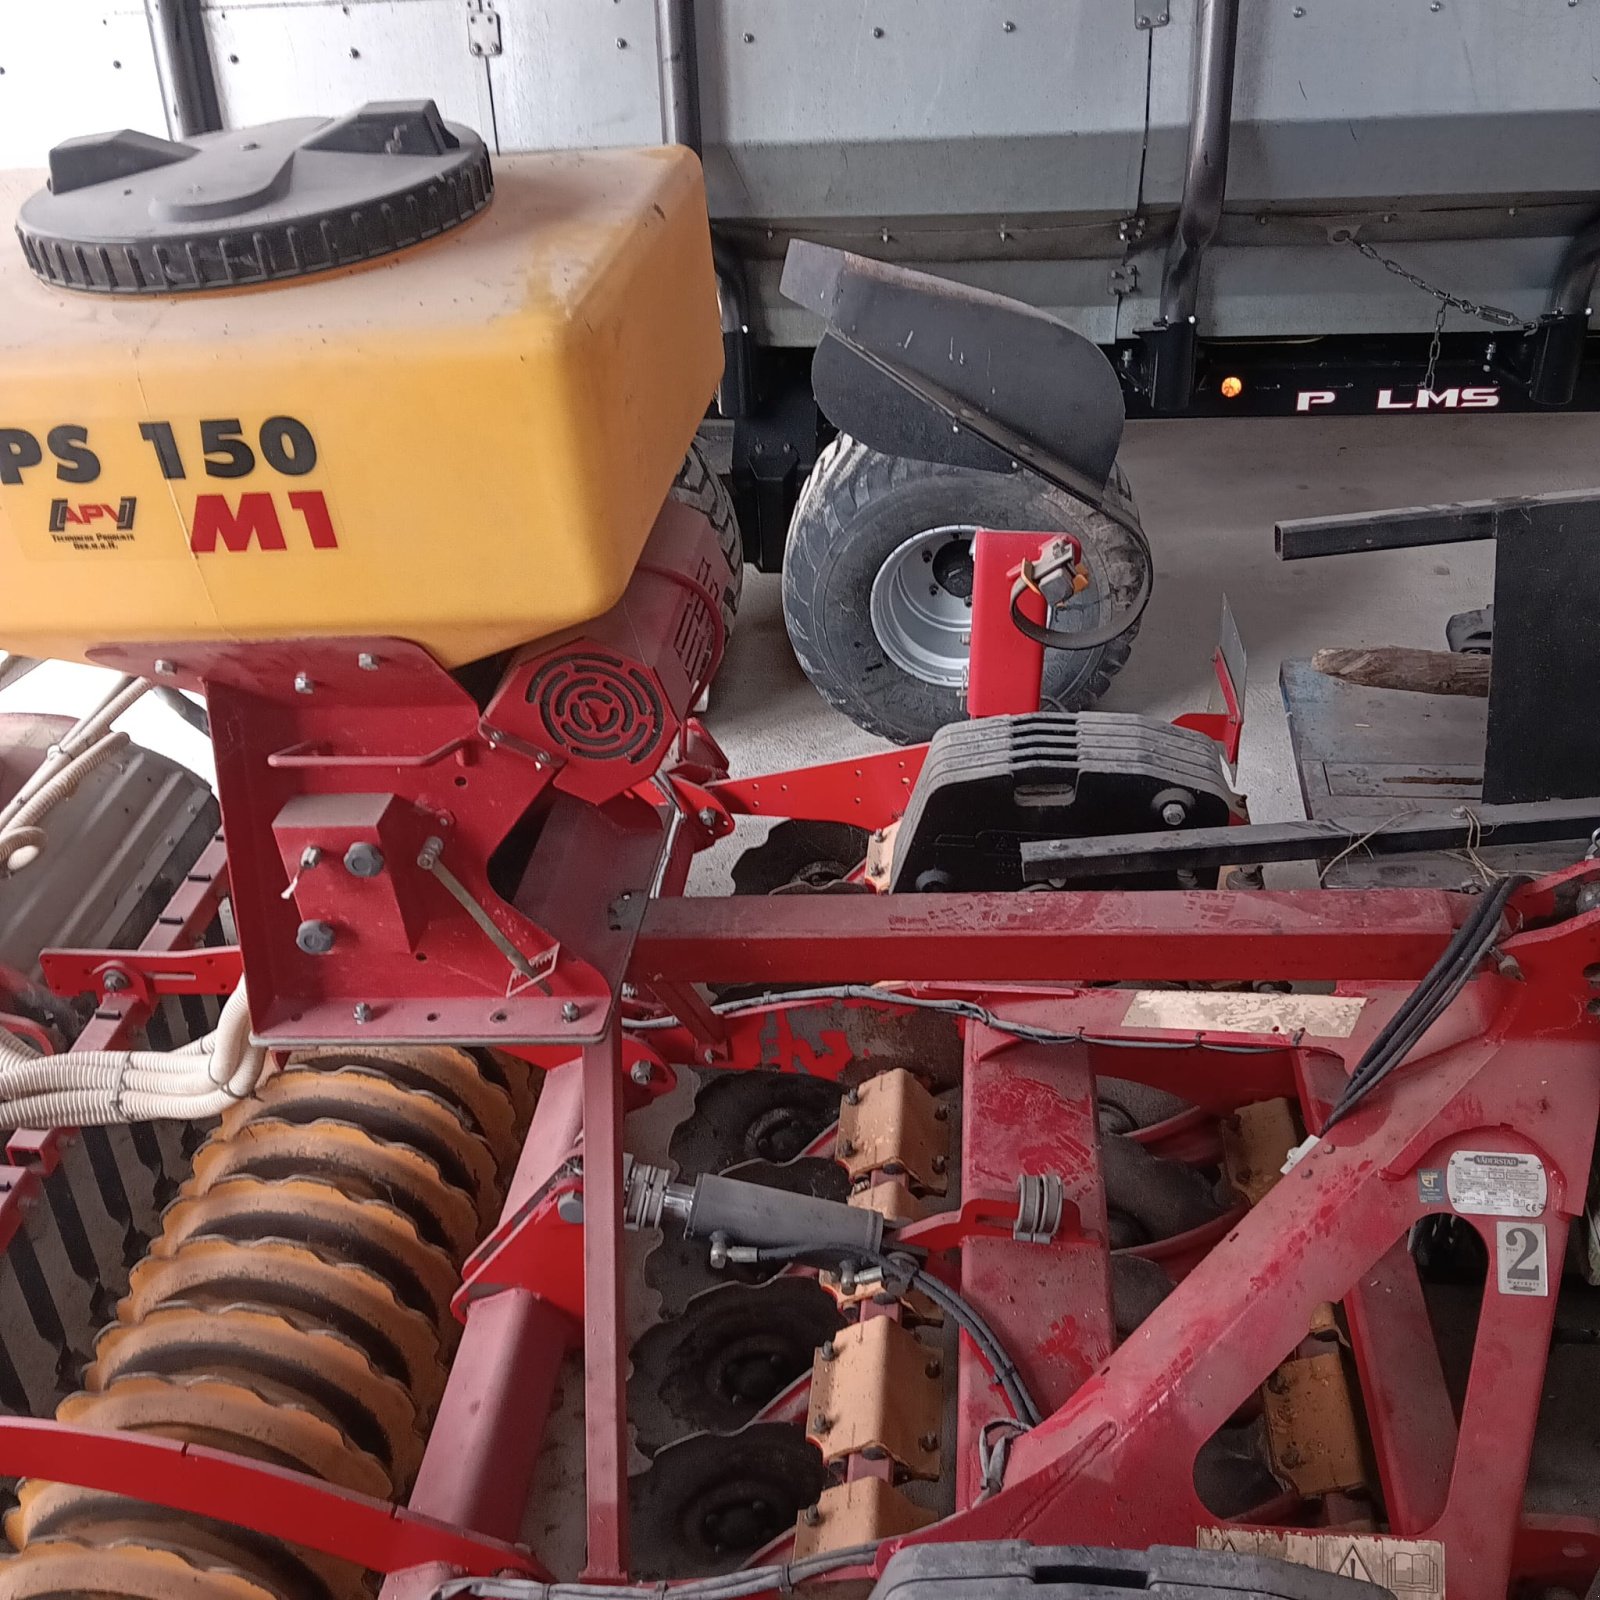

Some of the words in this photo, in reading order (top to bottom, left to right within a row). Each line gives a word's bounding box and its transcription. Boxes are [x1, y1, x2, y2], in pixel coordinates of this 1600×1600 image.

[1297, 391, 1336, 411] P
[1377, 388, 1500, 409] LMS
[0, 424, 101, 485] PS
[138, 415, 318, 480] 150
[190, 490, 338, 553] M1
[1505, 1227, 1539, 1280] 2
